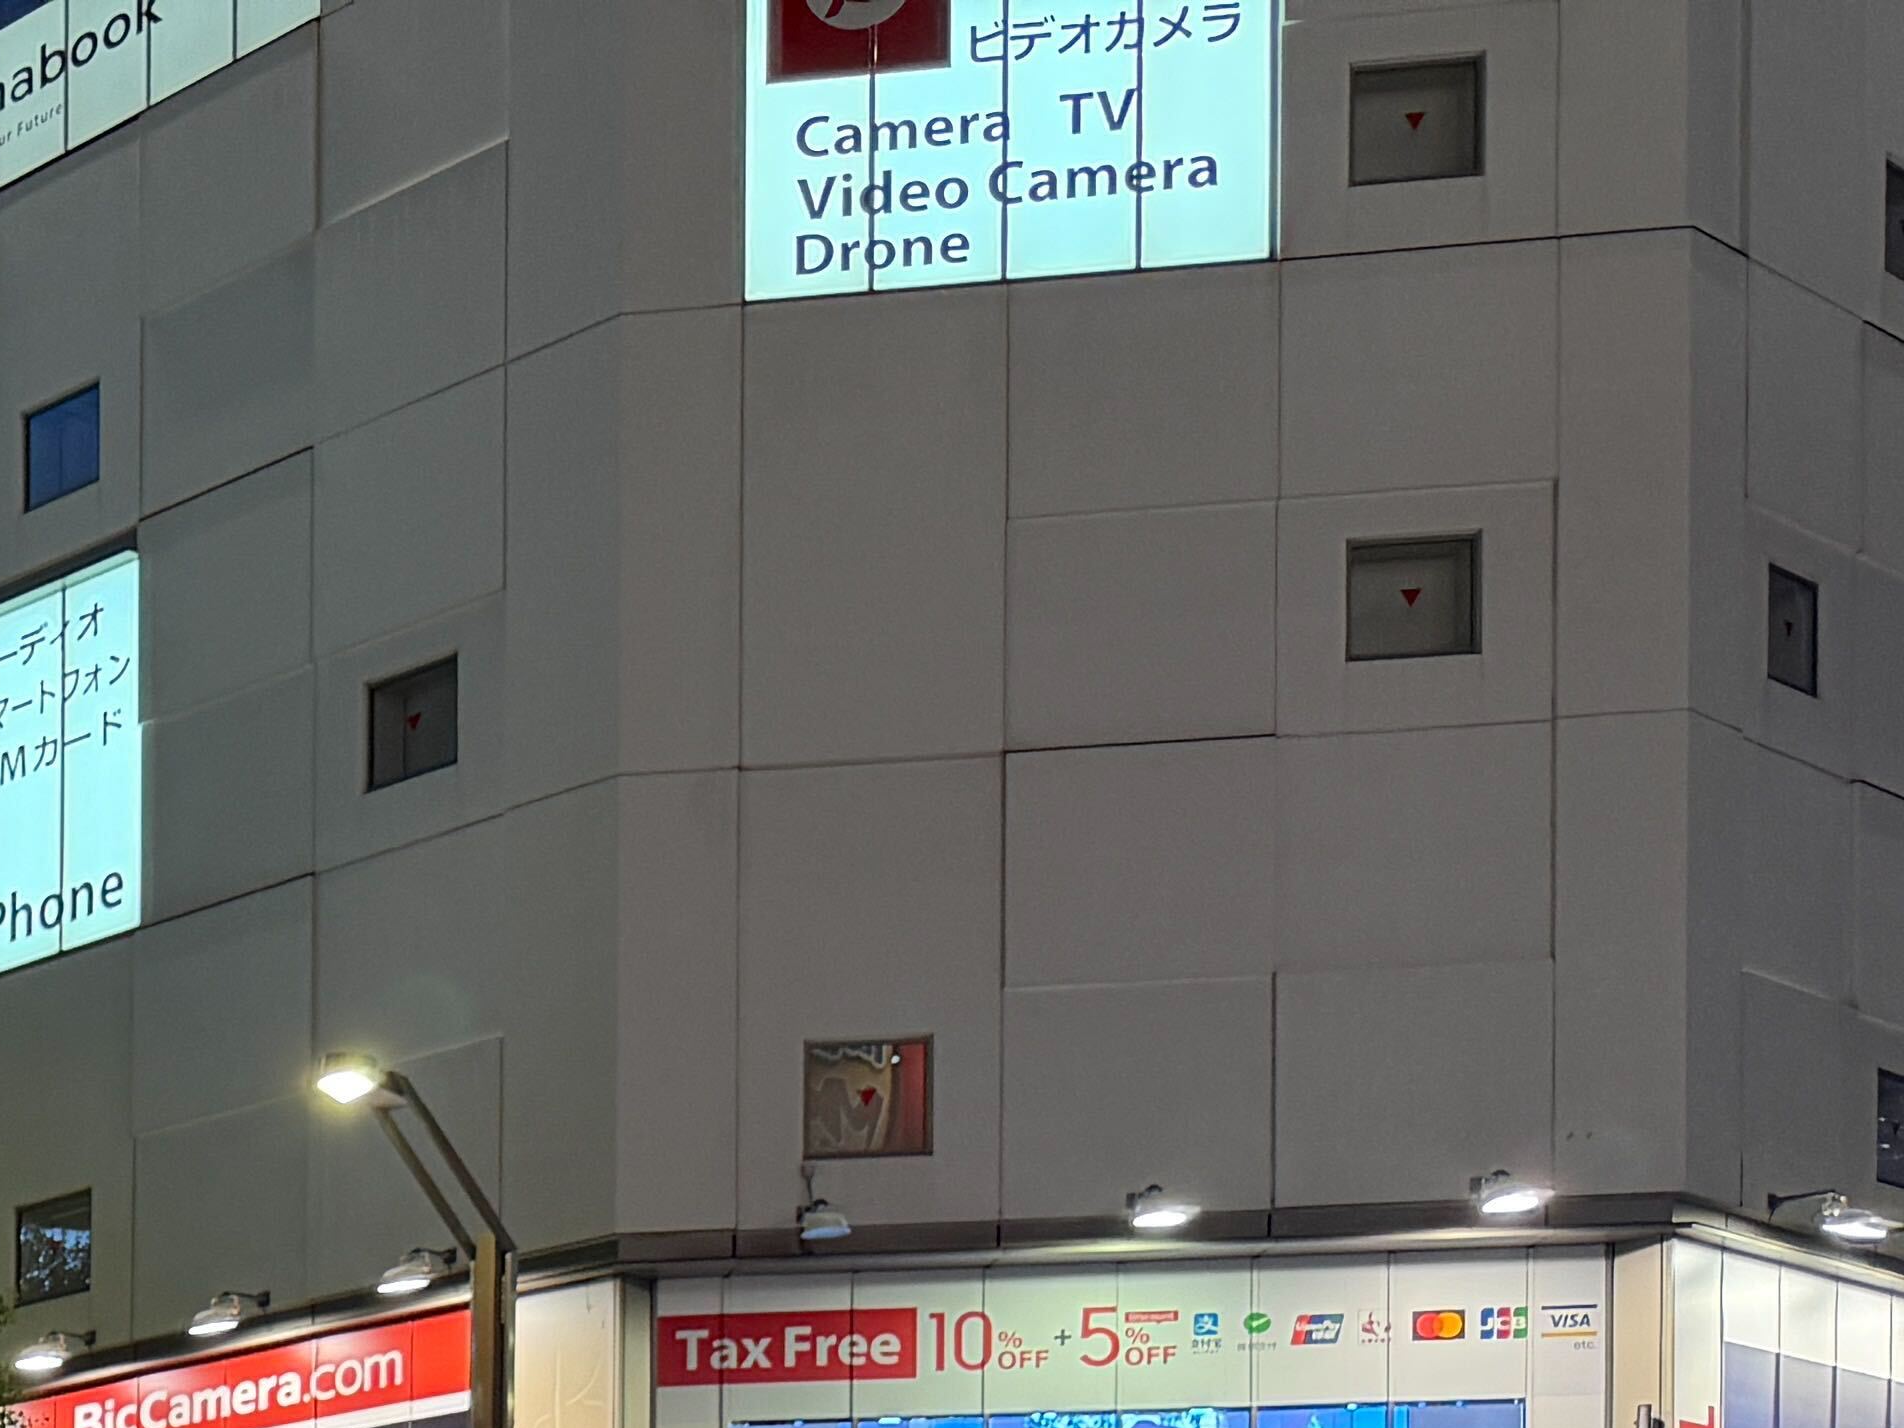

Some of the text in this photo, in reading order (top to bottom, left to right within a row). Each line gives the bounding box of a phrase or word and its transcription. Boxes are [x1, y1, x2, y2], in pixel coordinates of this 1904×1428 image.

[970, 2, 1241, 62] ビデオカメラ
[16, 103, 63, 138] Future
[796, 88, 1137, 158] Camera TV
[797, 154, 1218, 219] Video Camera
[796, 232, 970, 275] Drone
[675, 1328, 772, 1371] Tax
[783, 1325, 902, 1368] Free
[929, 1311, 993, 1372] 10
[997, 1349, 1049, 1371] OFF
[1079, 1306, 1121, 1369] 5
[1125, 1346, 1177, 1366] OFF
[1551, 1314, 1591, 1328] VISA
